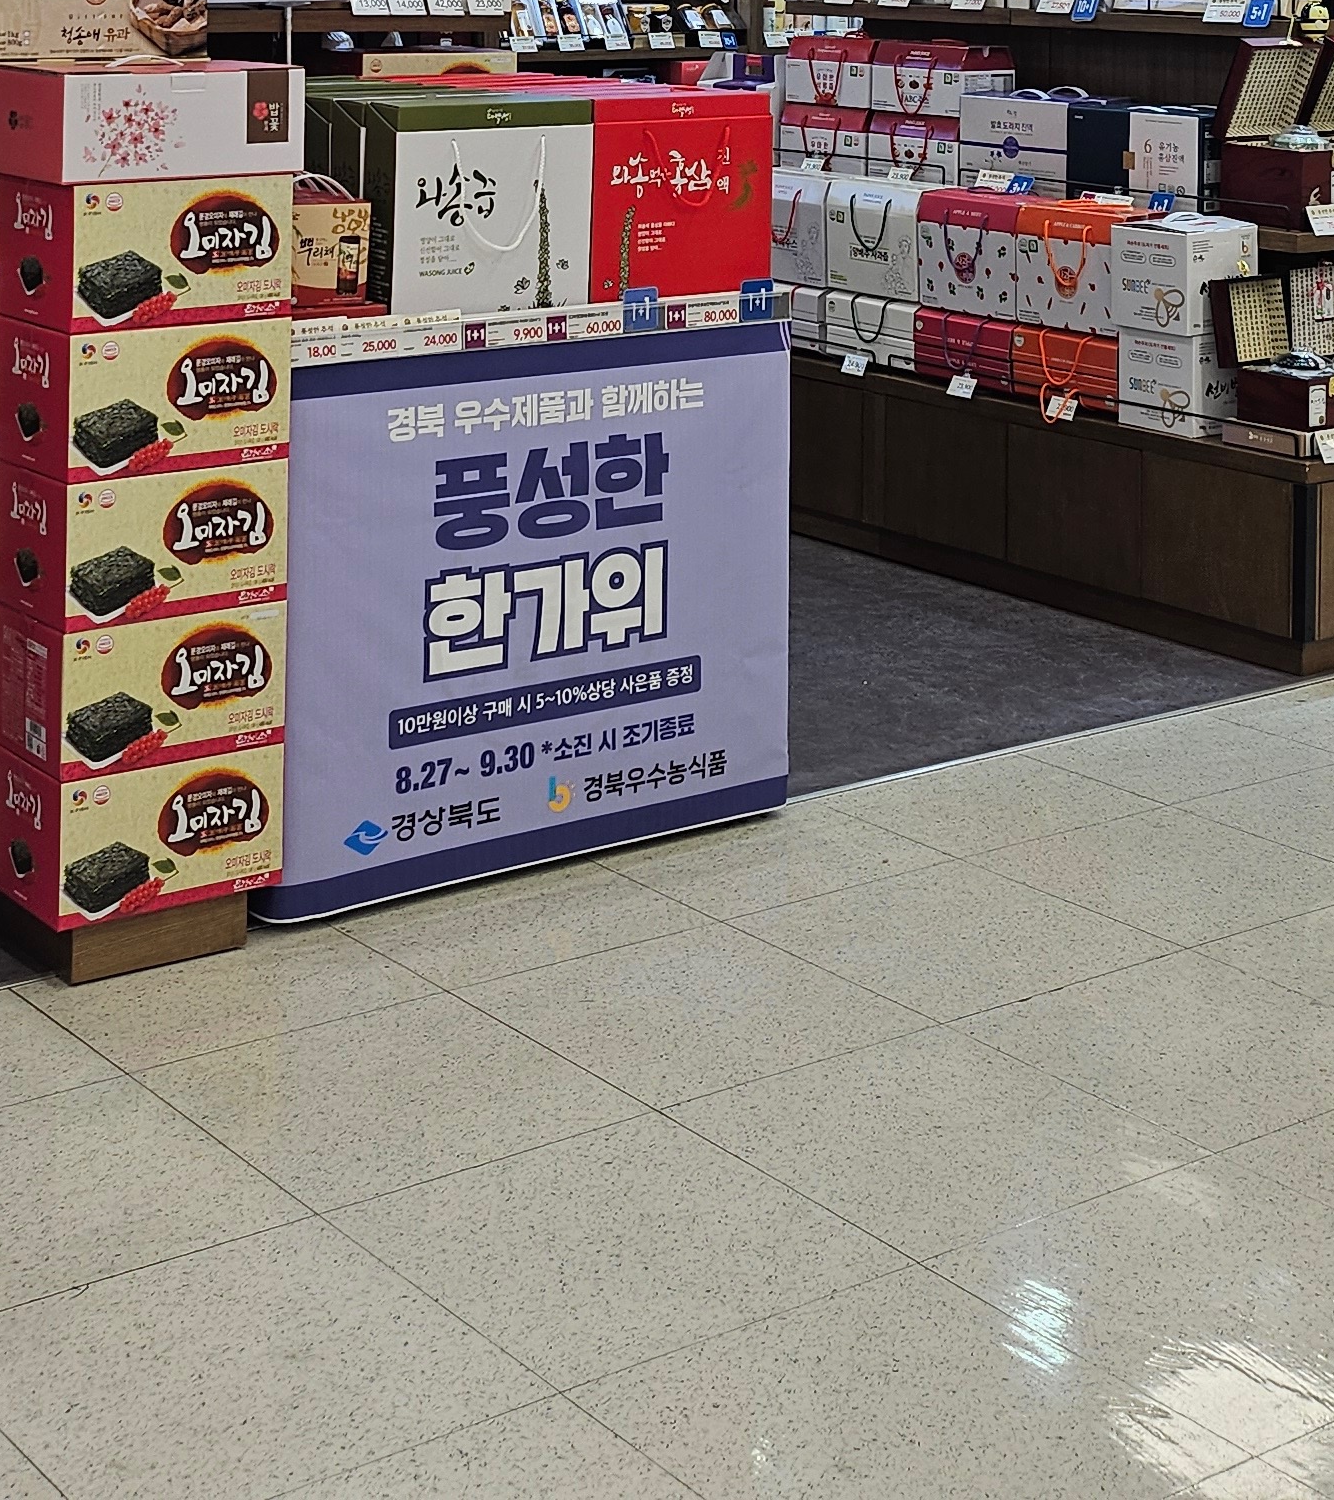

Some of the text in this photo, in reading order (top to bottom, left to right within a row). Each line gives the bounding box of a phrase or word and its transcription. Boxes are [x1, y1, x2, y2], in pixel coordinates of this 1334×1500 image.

[103, 26, 132, 42] 유과
[415, 163, 497, 227] 와송즙
[179, 210, 274, 260] 오미자김
[423, 332, 458, 348] 24,000
[466, 327, 544, 345] 1+1 9,900
[548, 319, 622, 336] 1+1 60,000
[668, 308, 738, 325] 1+1 80,000
[361, 339, 398, 354] 25,000
[176, 357, 270, 406] 오미자김
[386, 377, 705, 443] 경북 우수제품과 함께하는
[433, 432, 670, 551] 풍성한
[172, 500, 267, 551] 오미자김
[424, 540, 669, 682] 한가위
[171, 644, 265, 696] 오미자김
[397, 664, 694, 737] 10만원이상 구매 시 5~10%상당 사은품 증정
[395, 758, 470, 796] 8.27~
[480, 742, 536, 779] 9.30
[598, 729, 617, 751] 시
[623, 713, 696, 749] 조기종료
[583, 748, 729, 804] 경북우수농식품
[167, 788, 262, 843] 오미자김
[391, 796, 502, 842] 경상북도
